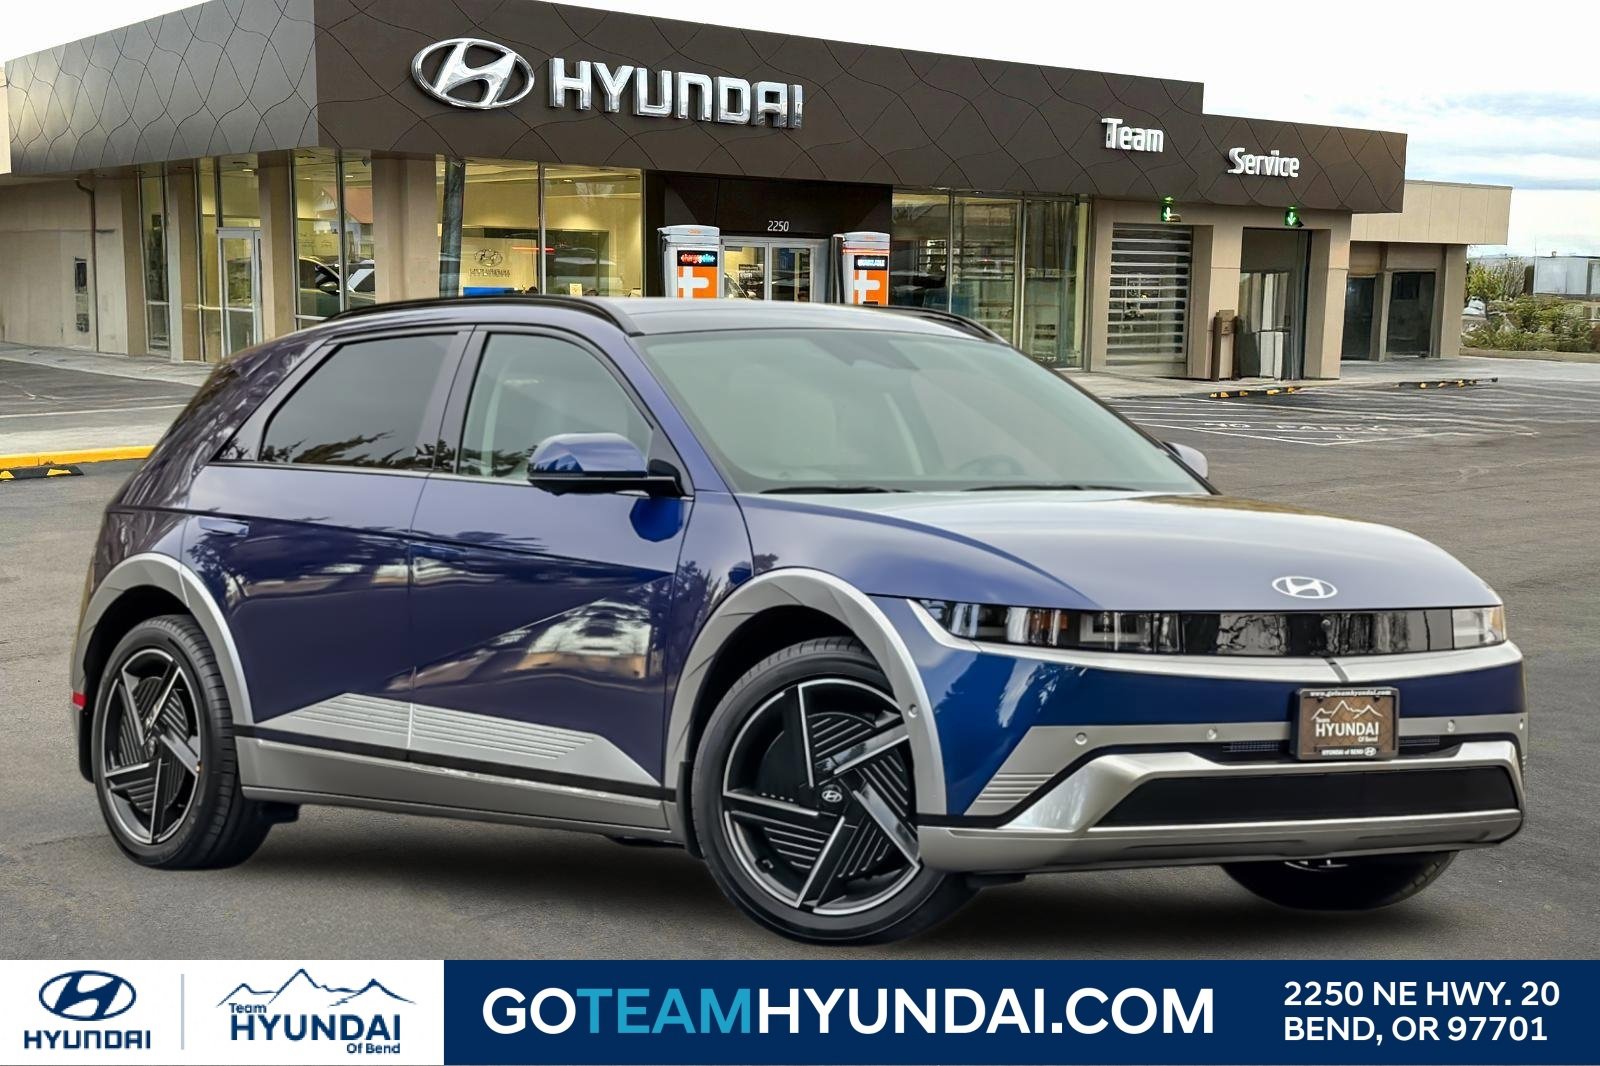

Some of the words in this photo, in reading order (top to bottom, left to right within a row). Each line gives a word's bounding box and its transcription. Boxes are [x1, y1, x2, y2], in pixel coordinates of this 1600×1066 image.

[549, 57, 804, 129] HYUNDAI
[1101, 117, 1164, 153] Team
[1227, 147, 1300, 178] Service
[767, 220, 790, 232] 2250
[1316, 722, 1379, 737] HYUNDAI
